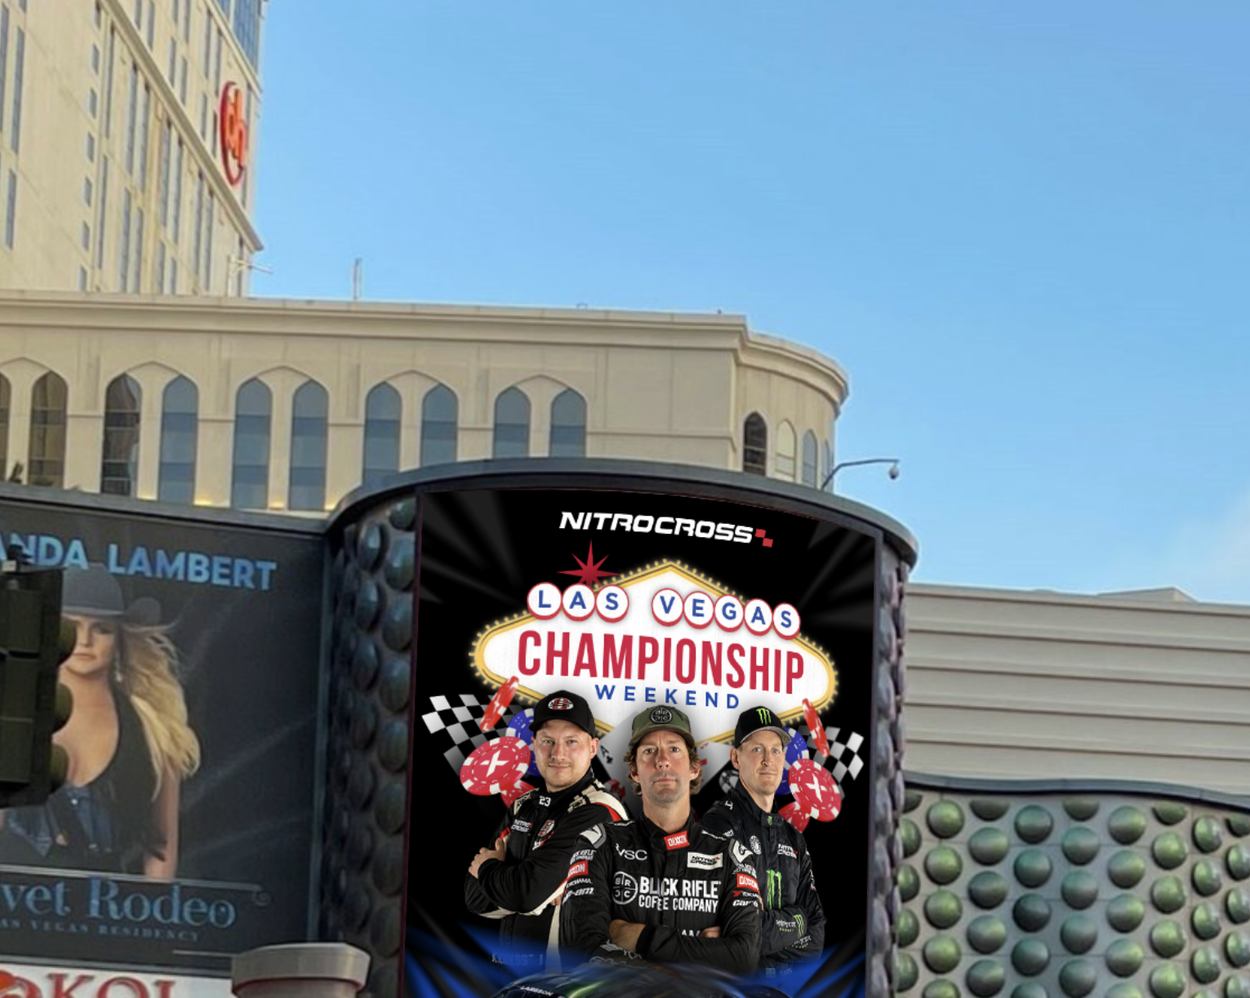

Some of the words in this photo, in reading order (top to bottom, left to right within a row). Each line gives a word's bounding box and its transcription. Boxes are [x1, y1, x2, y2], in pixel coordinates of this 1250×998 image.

[559, 511, 754, 544] NITROCROSS
[0, 532, 89, 570] NDA
[107, 543, 278, 591] LAMBERT
[538, 590, 619, 612] LAS
[660, 596, 793, 628] VEGAS
[517, 630, 804, 695] CHAMPIONSHIP
[594, 683, 740, 710] WEEKEND
[89, 875, 236, 928] Rodeo
[672, 898, 719, 913] COMPANY
[682, 879, 720, 899] RIFLE
[31, 920, 89, 934] VEGAS
